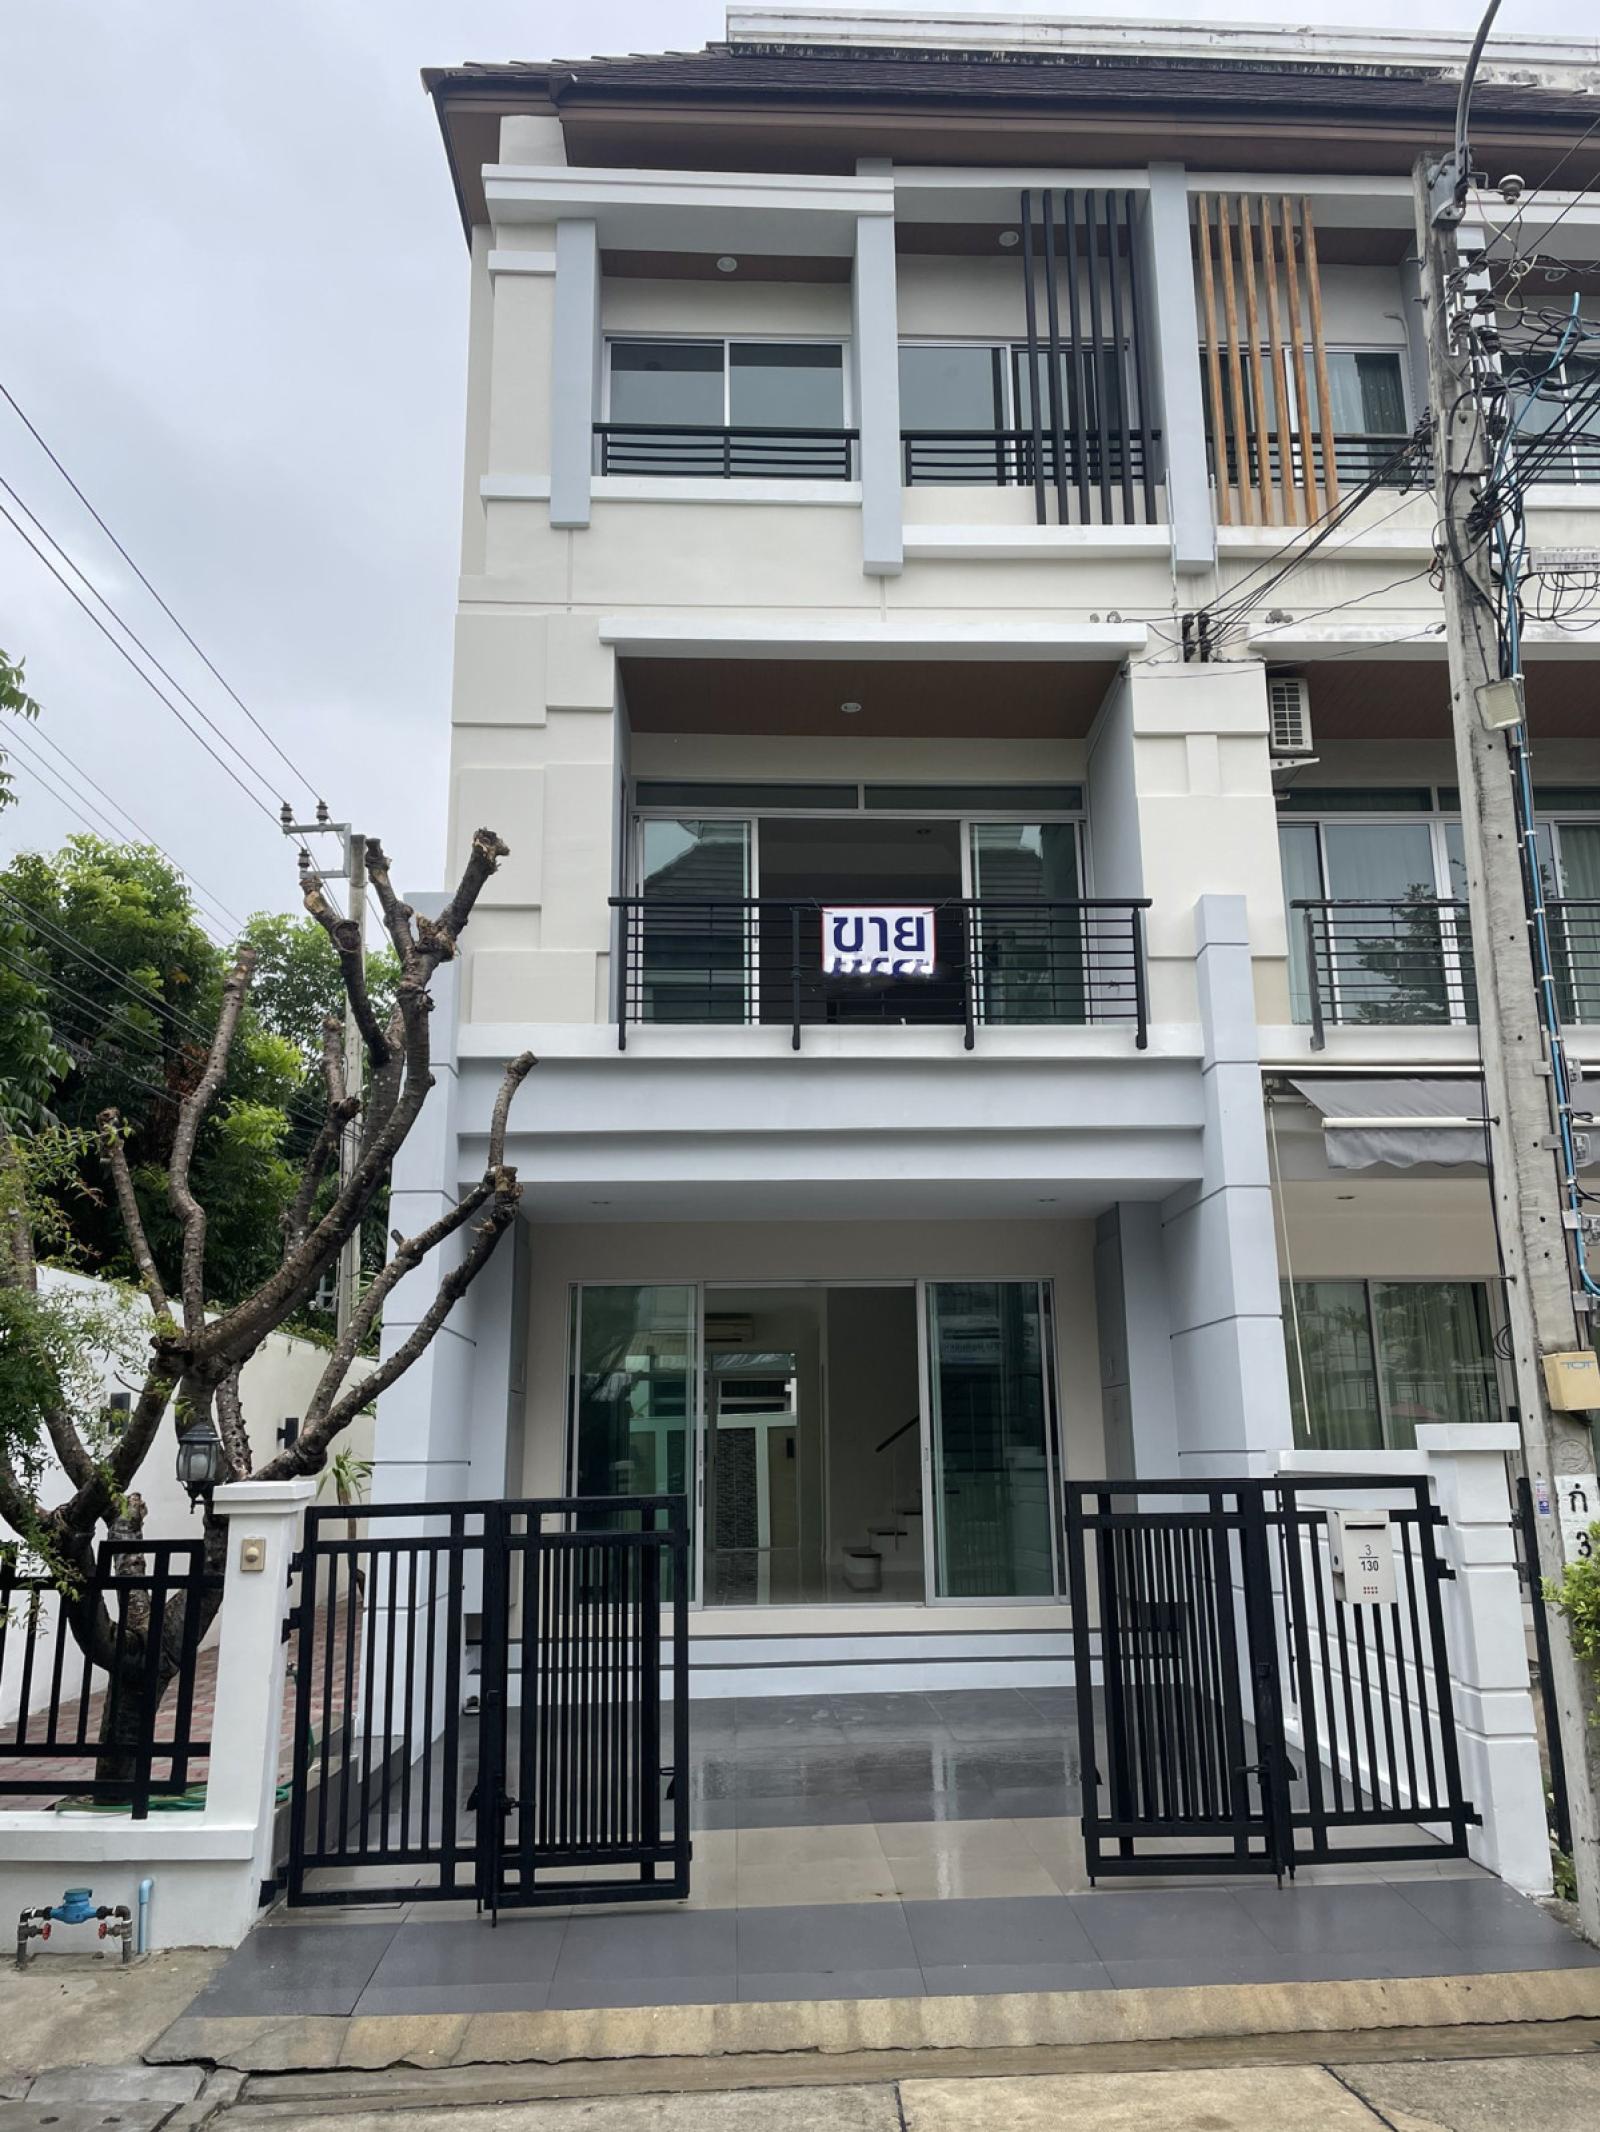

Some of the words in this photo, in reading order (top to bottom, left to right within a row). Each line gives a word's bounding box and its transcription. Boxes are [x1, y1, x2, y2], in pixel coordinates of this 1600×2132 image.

[833, 916, 925, 952] ขาย
[1364, 1544, 1371, 1555] 3
[1361, 1560, 1379, 1571] 130
